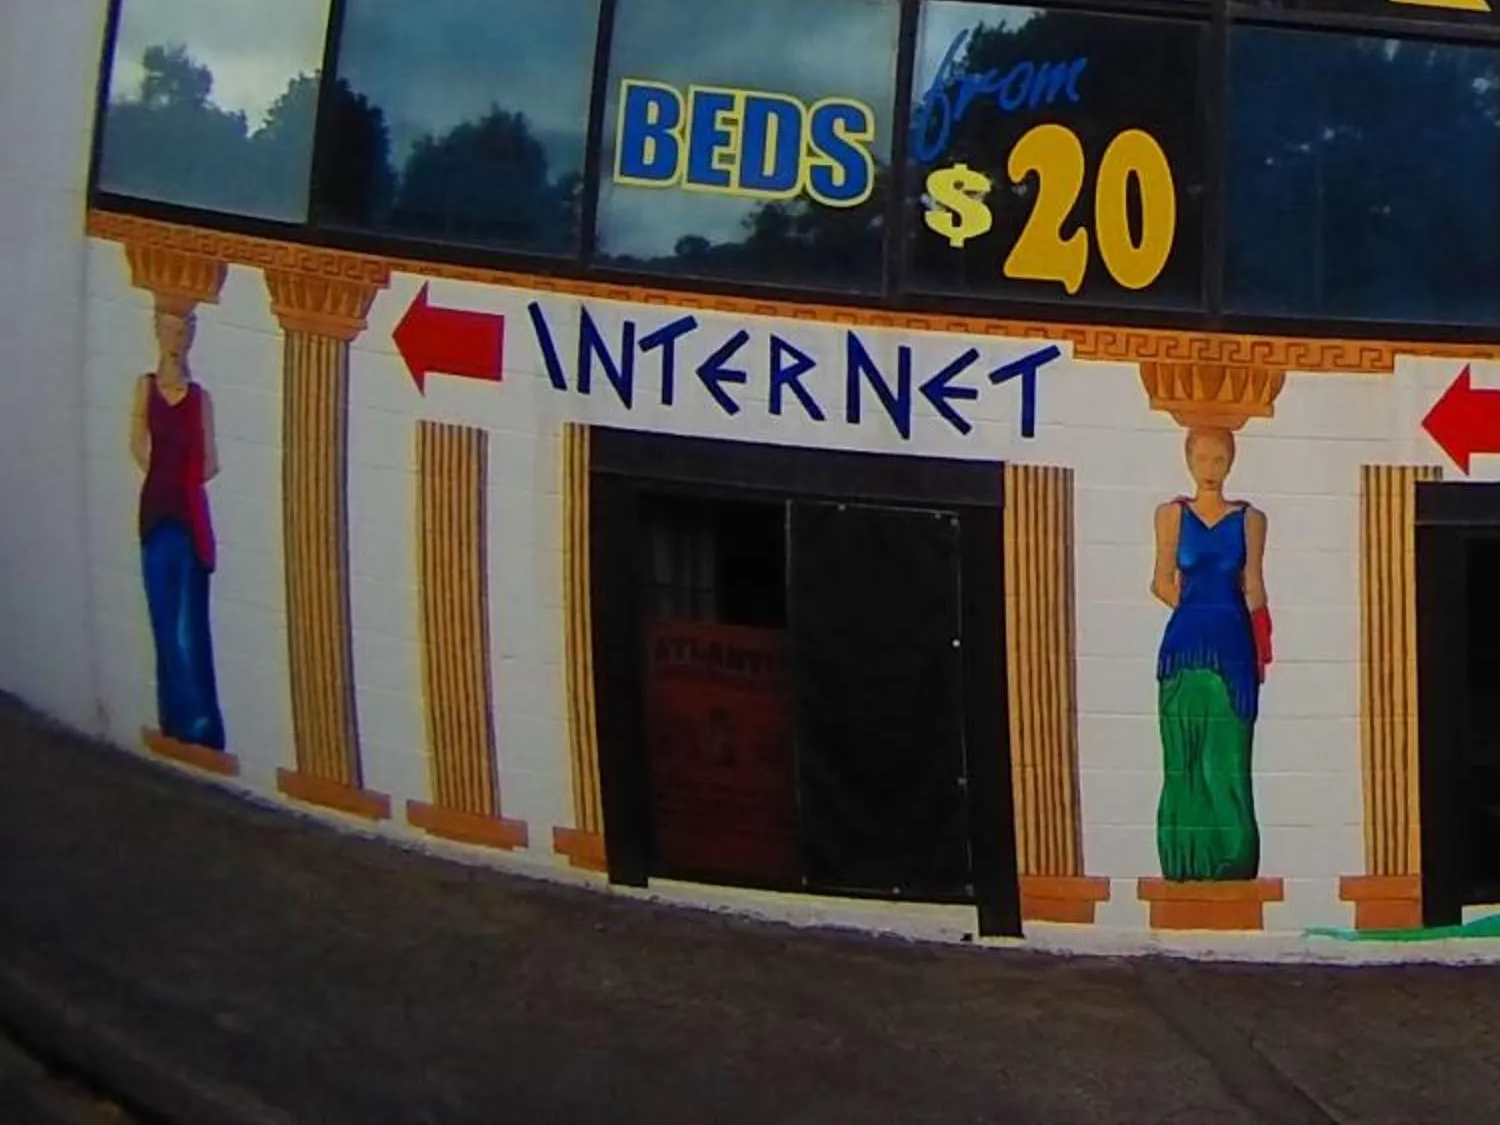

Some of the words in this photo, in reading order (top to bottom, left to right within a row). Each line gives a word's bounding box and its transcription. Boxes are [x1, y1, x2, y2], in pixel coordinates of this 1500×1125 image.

[614, 79, 874, 207] BEDS
[914, 28, 1087, 161] from
[925, 124, 1176, 295] $20
[528, 301, 1061, 439] INTERNET
